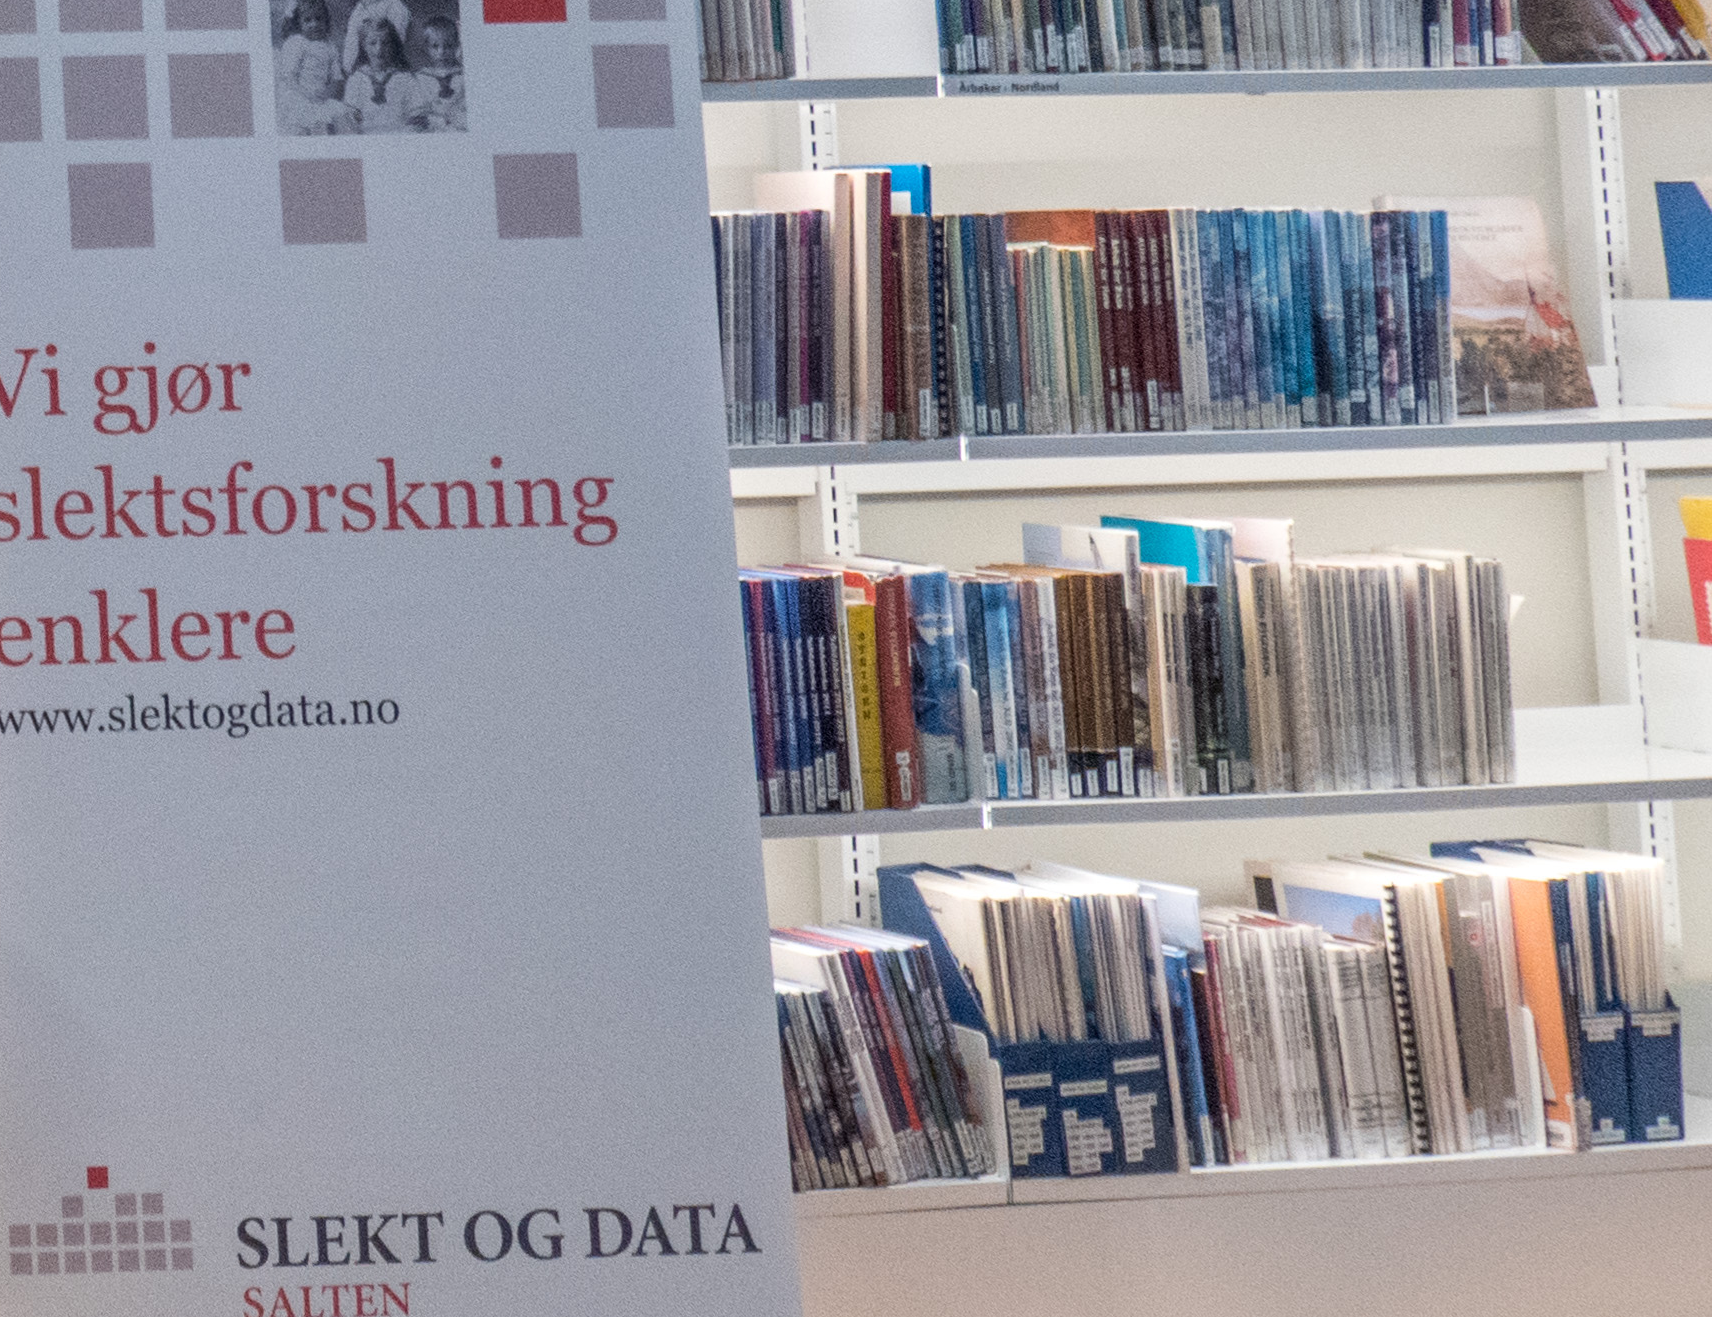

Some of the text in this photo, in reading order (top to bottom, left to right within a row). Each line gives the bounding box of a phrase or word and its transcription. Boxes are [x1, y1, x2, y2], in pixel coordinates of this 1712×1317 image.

[91, 341, 252, 435] gjør
[235, 1202, 763, 1269] SLEKT OG DATA
[242, 1283, 412, 1317] SALTEN
